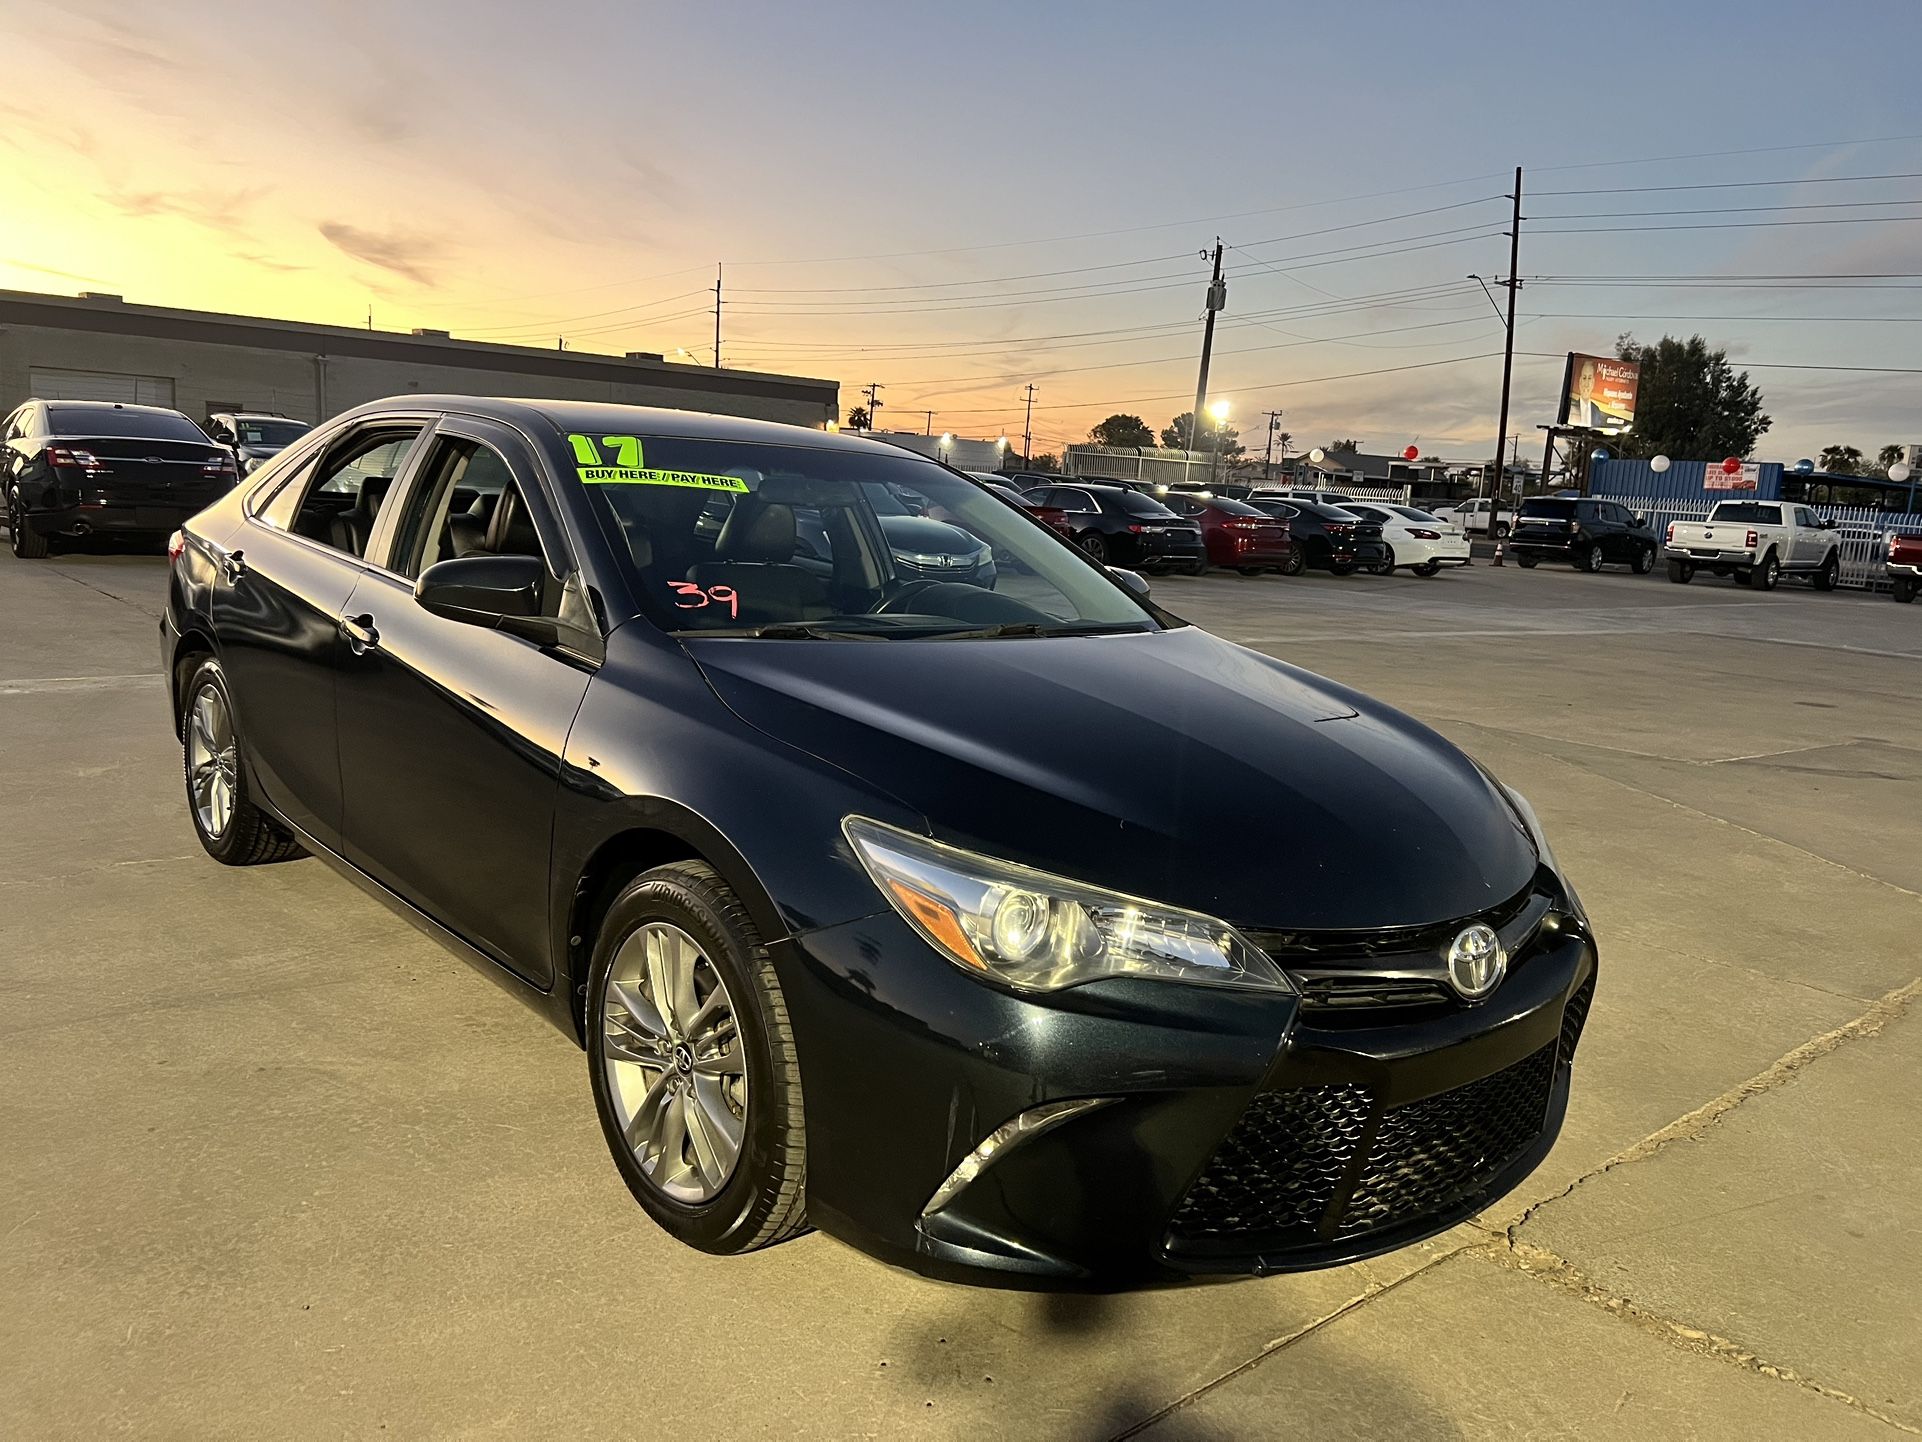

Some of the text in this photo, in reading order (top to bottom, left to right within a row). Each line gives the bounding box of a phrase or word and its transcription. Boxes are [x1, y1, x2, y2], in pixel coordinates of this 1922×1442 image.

[567, 434, 644, 468] 17
[585, 469, 615, 479] BUY
[619, 470, 658, 480] HERE
[671, 472, 697, 484] PAY
[702, 476, 739, 488] HERE
[667, 580, 739, 620] 39
